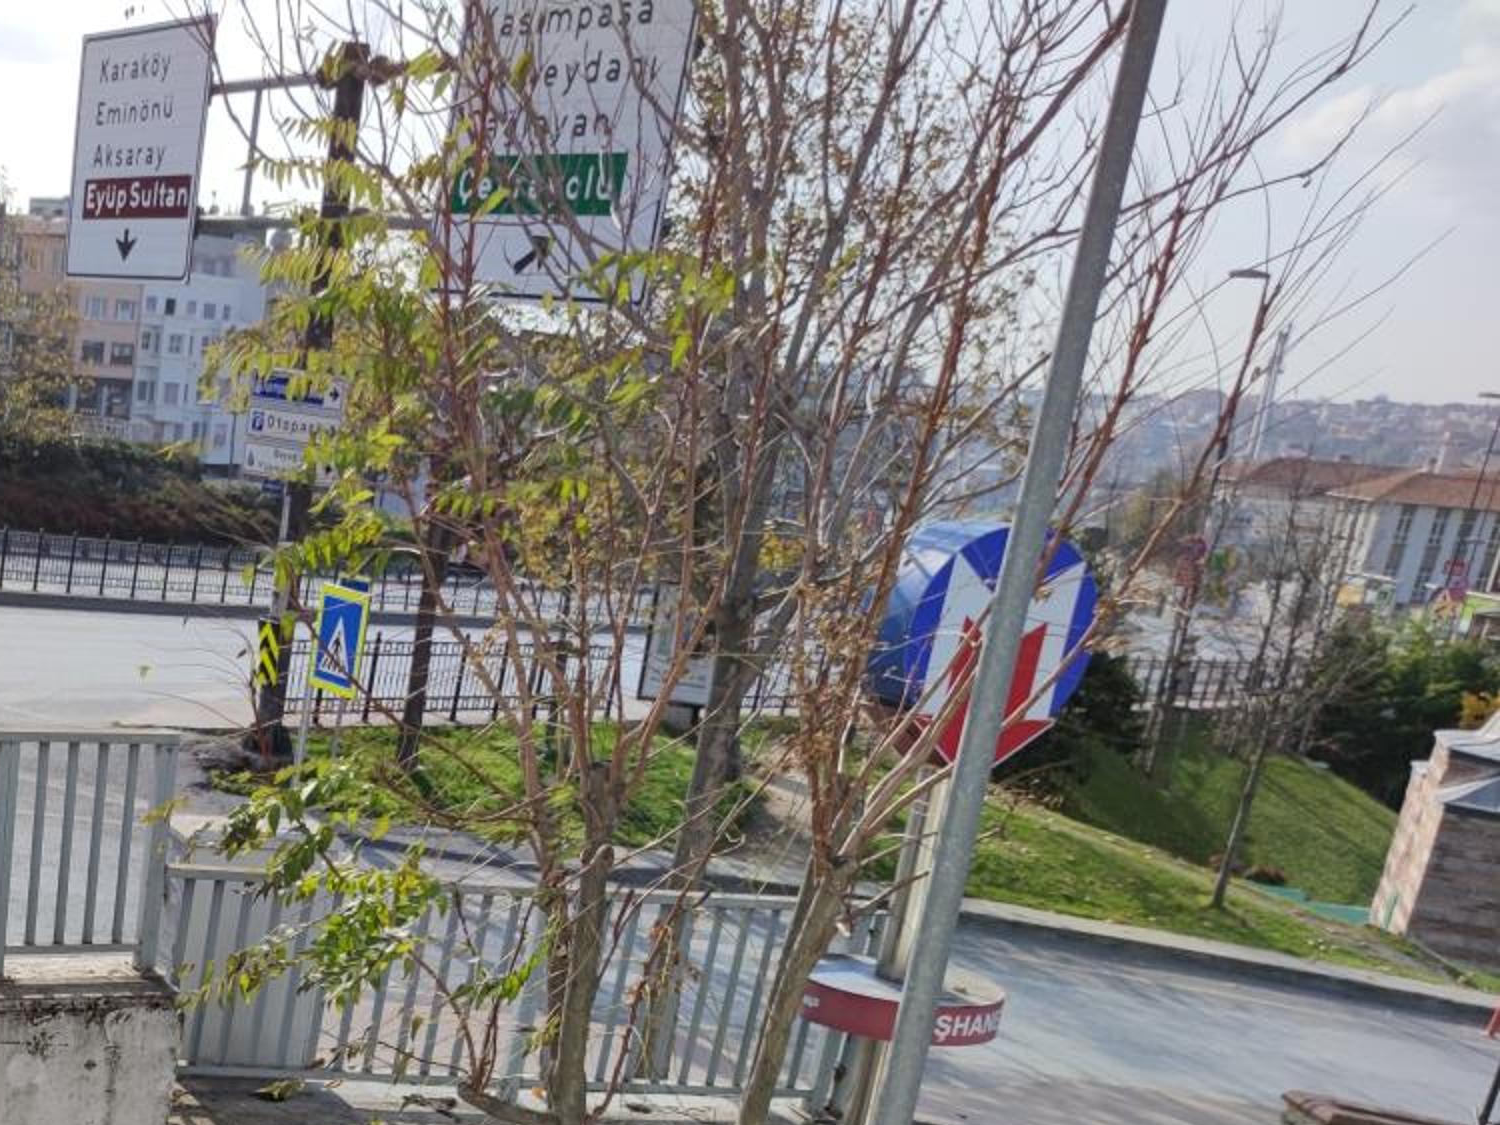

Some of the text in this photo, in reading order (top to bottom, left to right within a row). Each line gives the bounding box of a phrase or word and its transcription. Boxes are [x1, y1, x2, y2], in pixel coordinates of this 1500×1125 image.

[100, 51, 171, 84] Karaköy
[95, 96, 174, 126] Eminönü
[93, 144, 166, 171] Aksaray
[85, 180, 188, 216] Eyüp Sultan
